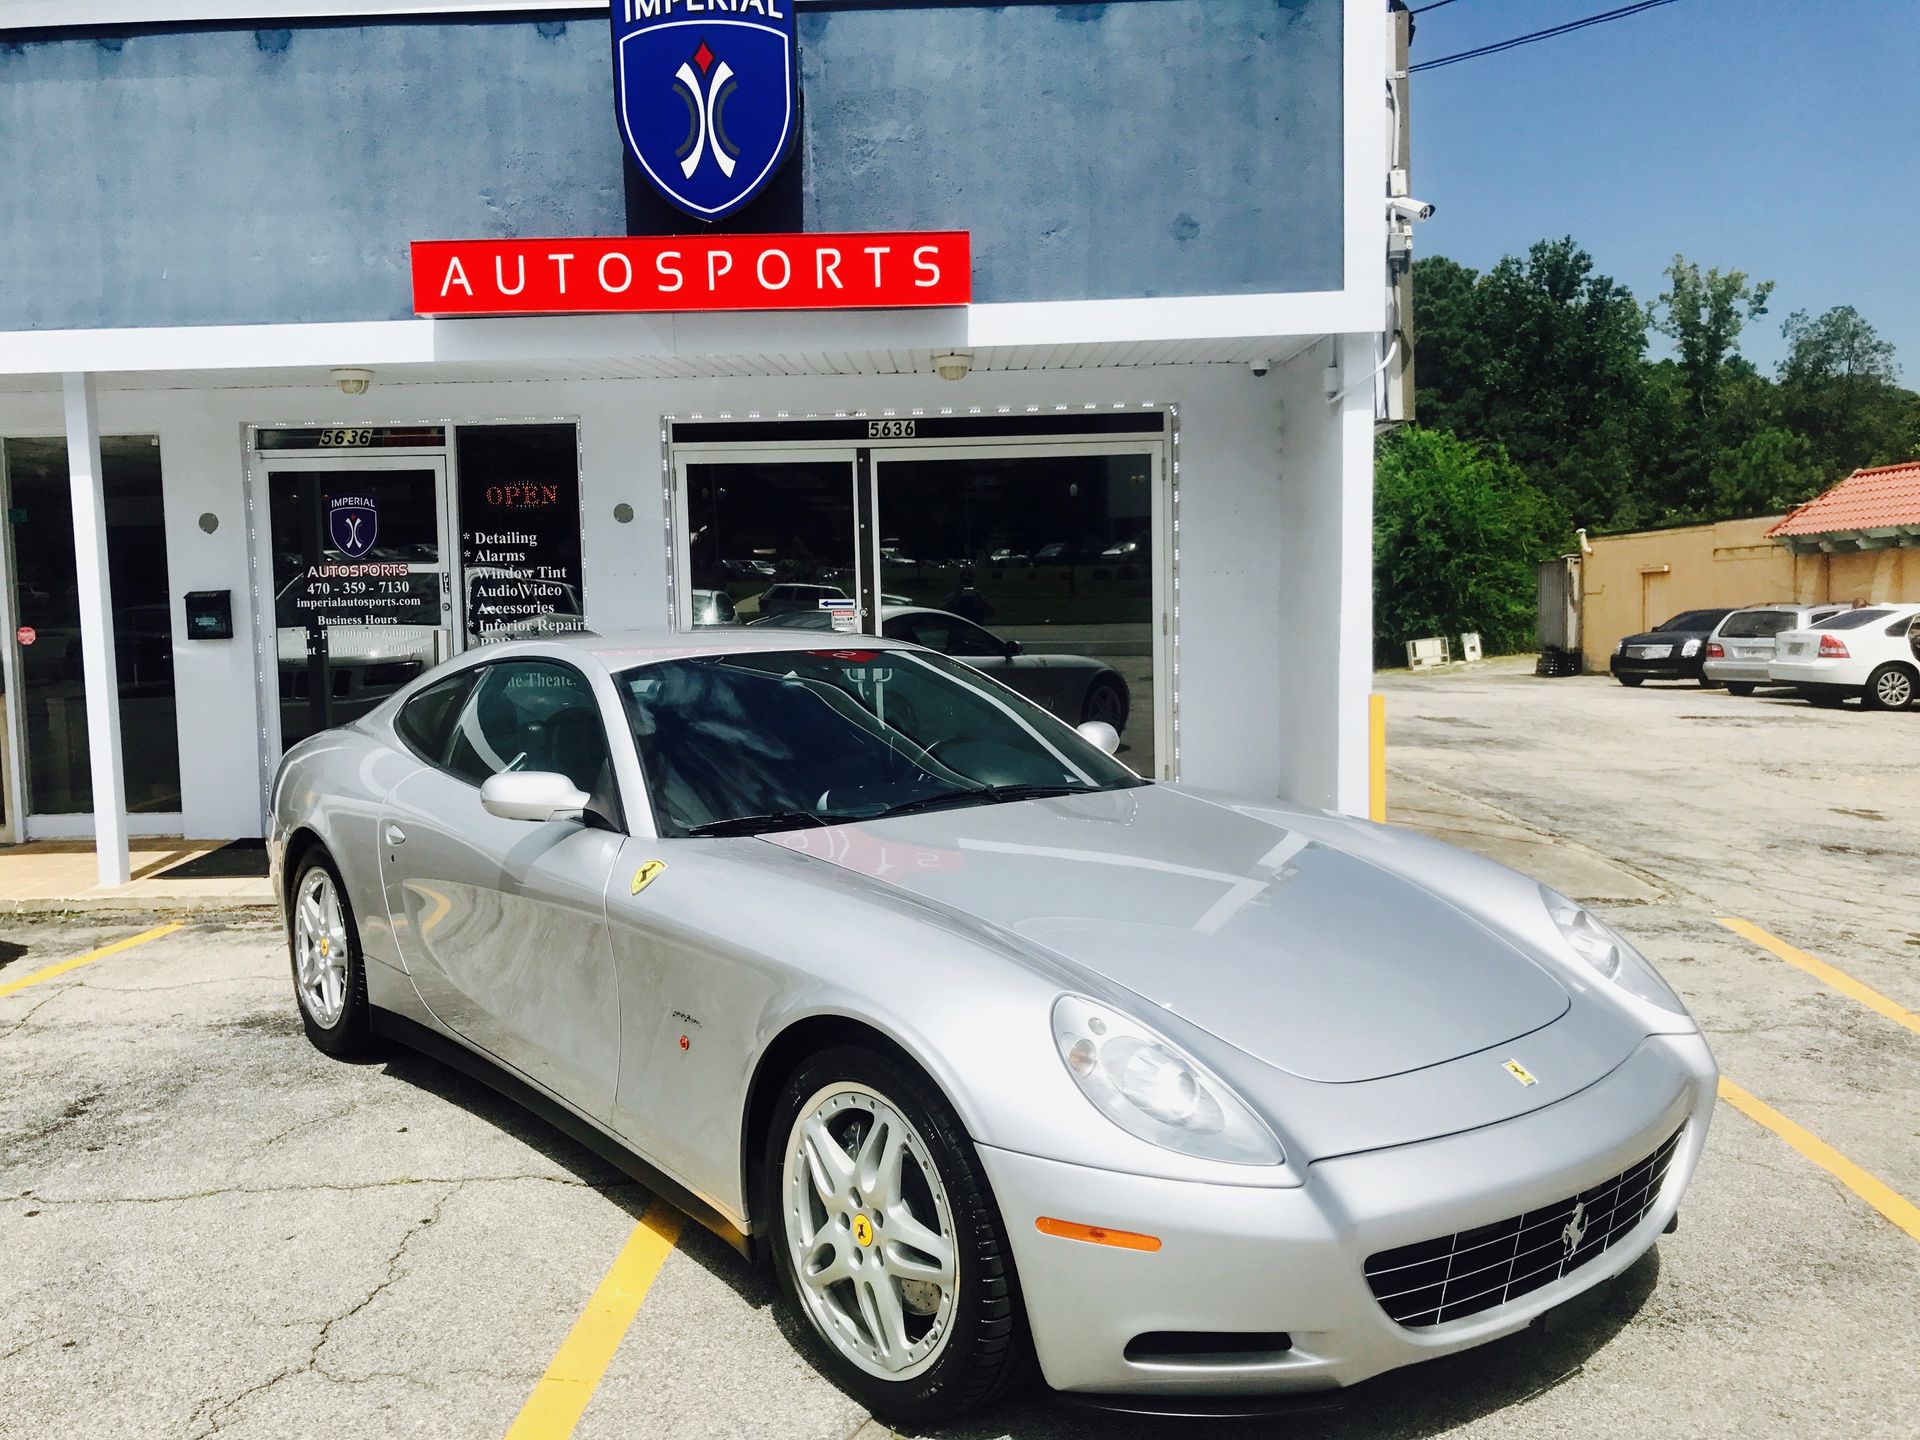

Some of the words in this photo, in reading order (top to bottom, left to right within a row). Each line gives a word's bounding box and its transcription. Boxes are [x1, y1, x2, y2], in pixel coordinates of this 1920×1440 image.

[440, 246, 940, 297] AUTOSPORTS
[870, 421, 914, 437] 5636
[321, 429, 371, 445] 5636
[331, 497, 376, 508] IMPERIAL
[485, 485, 558, 506] OPEN
[474, 531, 538, 547] Detailing
[474, 549, 526, 562] Alarms
[306, 564, 409, 578] AUTOSPORTS
[476, 565, 535, 580] Window
[537, 566, 567, 579] Tint
[306, 582, 330, 595] 470
[342, 581, 366, 594] 359
[378, 581, 410, 594] 7130
[296, 597, 421, 610] imperialautosports.com
[477, 601, 555, 615] Accessories
[317, 615, 362, 626] Business
[365, 614, 398, 625] Hours
[479, 618, 532, 632] Interior
[538, 619, 585, 634] Repair
[526, 673, 577, 688] Theat
